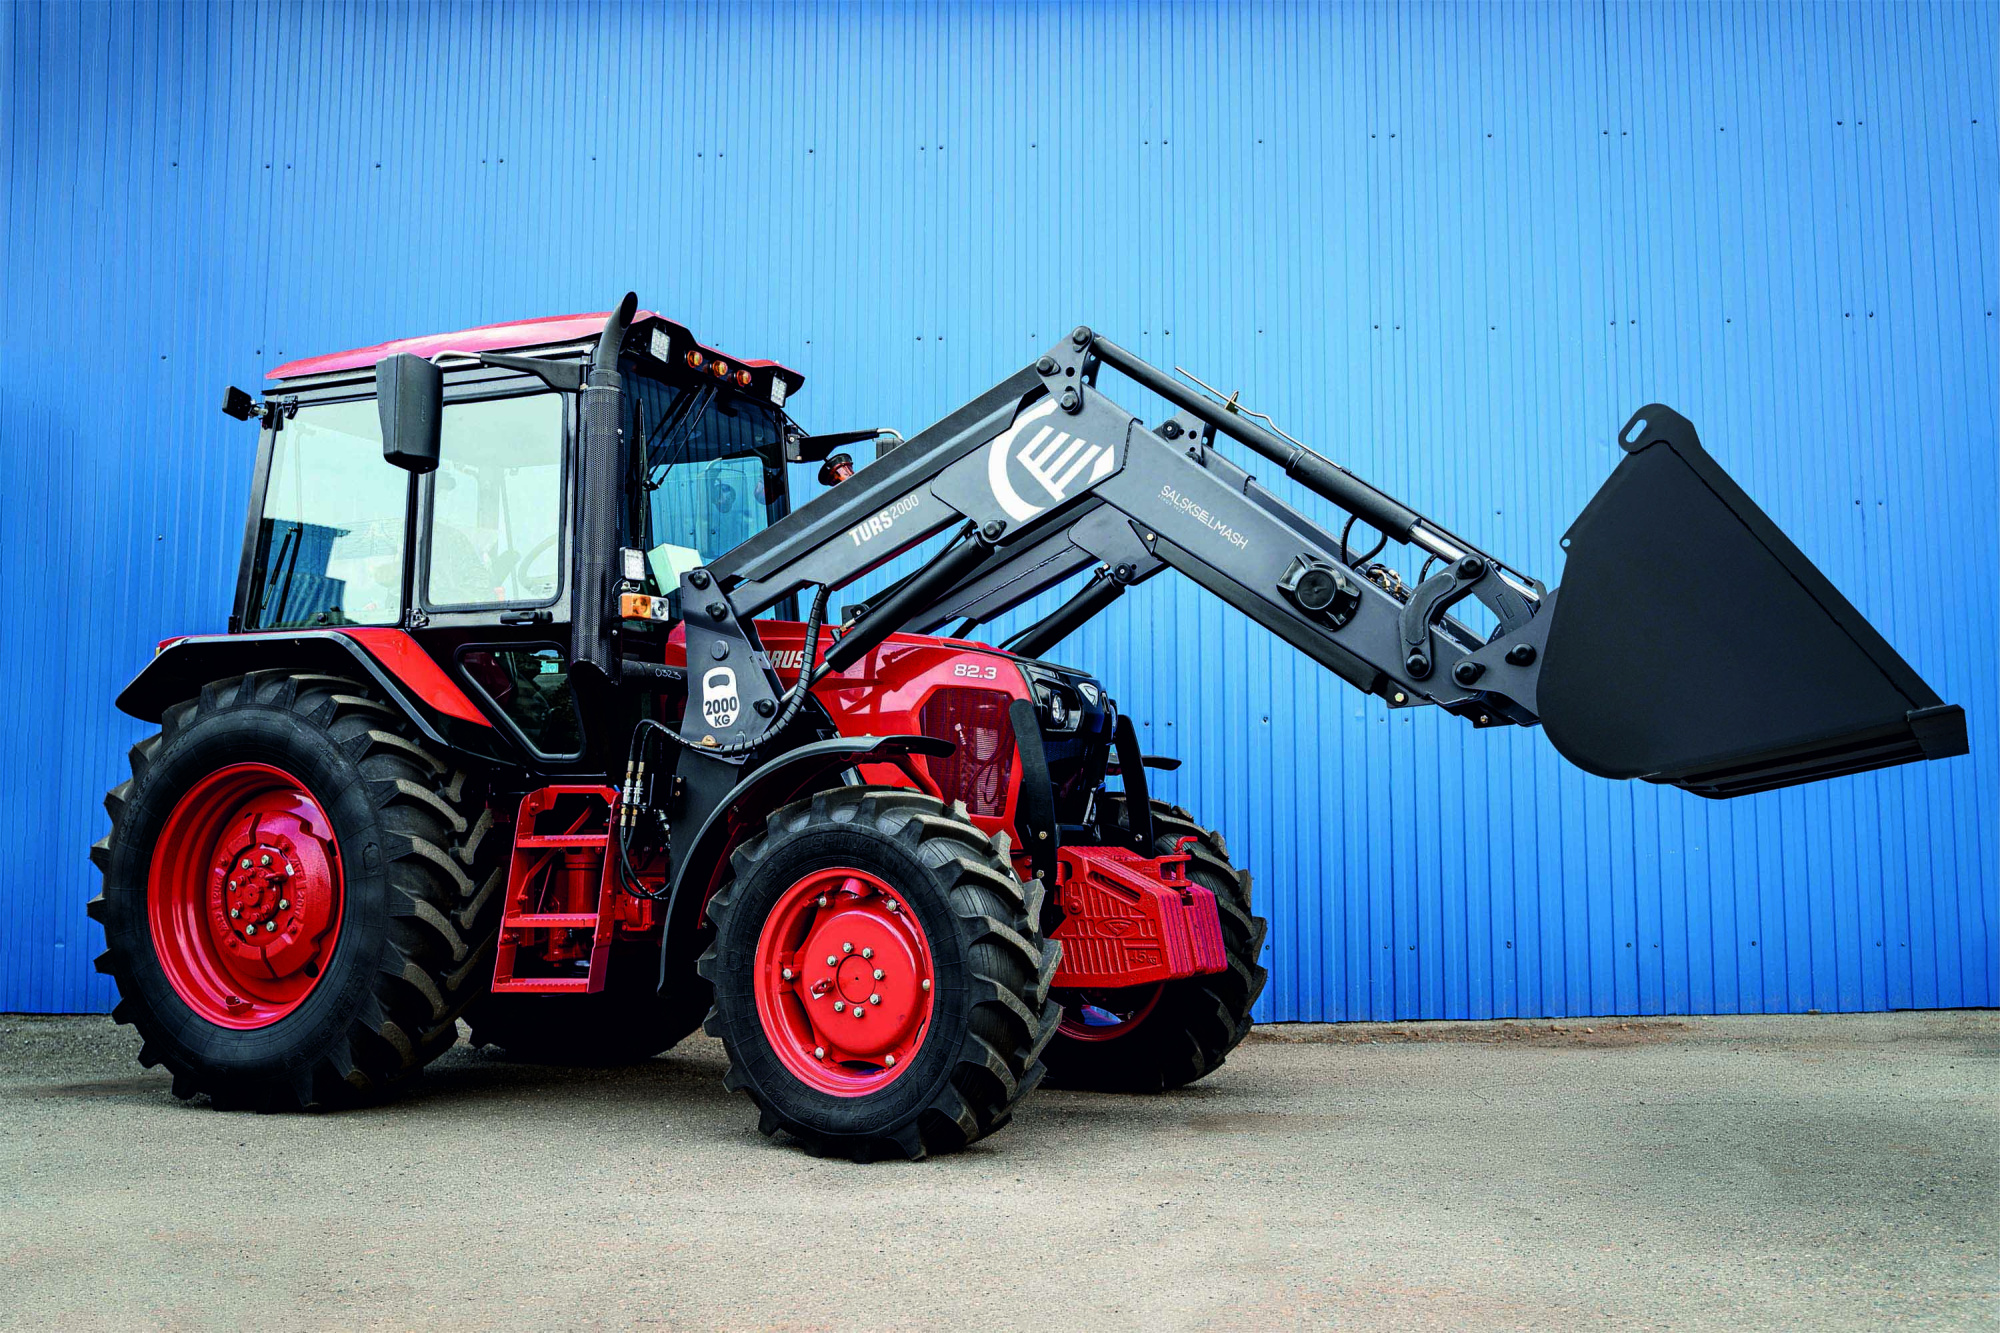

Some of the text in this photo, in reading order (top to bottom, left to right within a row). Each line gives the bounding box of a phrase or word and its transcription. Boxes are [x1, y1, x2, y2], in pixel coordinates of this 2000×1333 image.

[1160, 485, 1249, 550] SALSKSELMASH
[767, 650, 805, 669] RUS
[655, 667, 682, 680] 0323
[954, 663, 997, 680] 82.3
[705, 696, 738, 716] 2000
[714, 715, 731, 727] KG
[779, 833, 876, 866] BELSHINA
